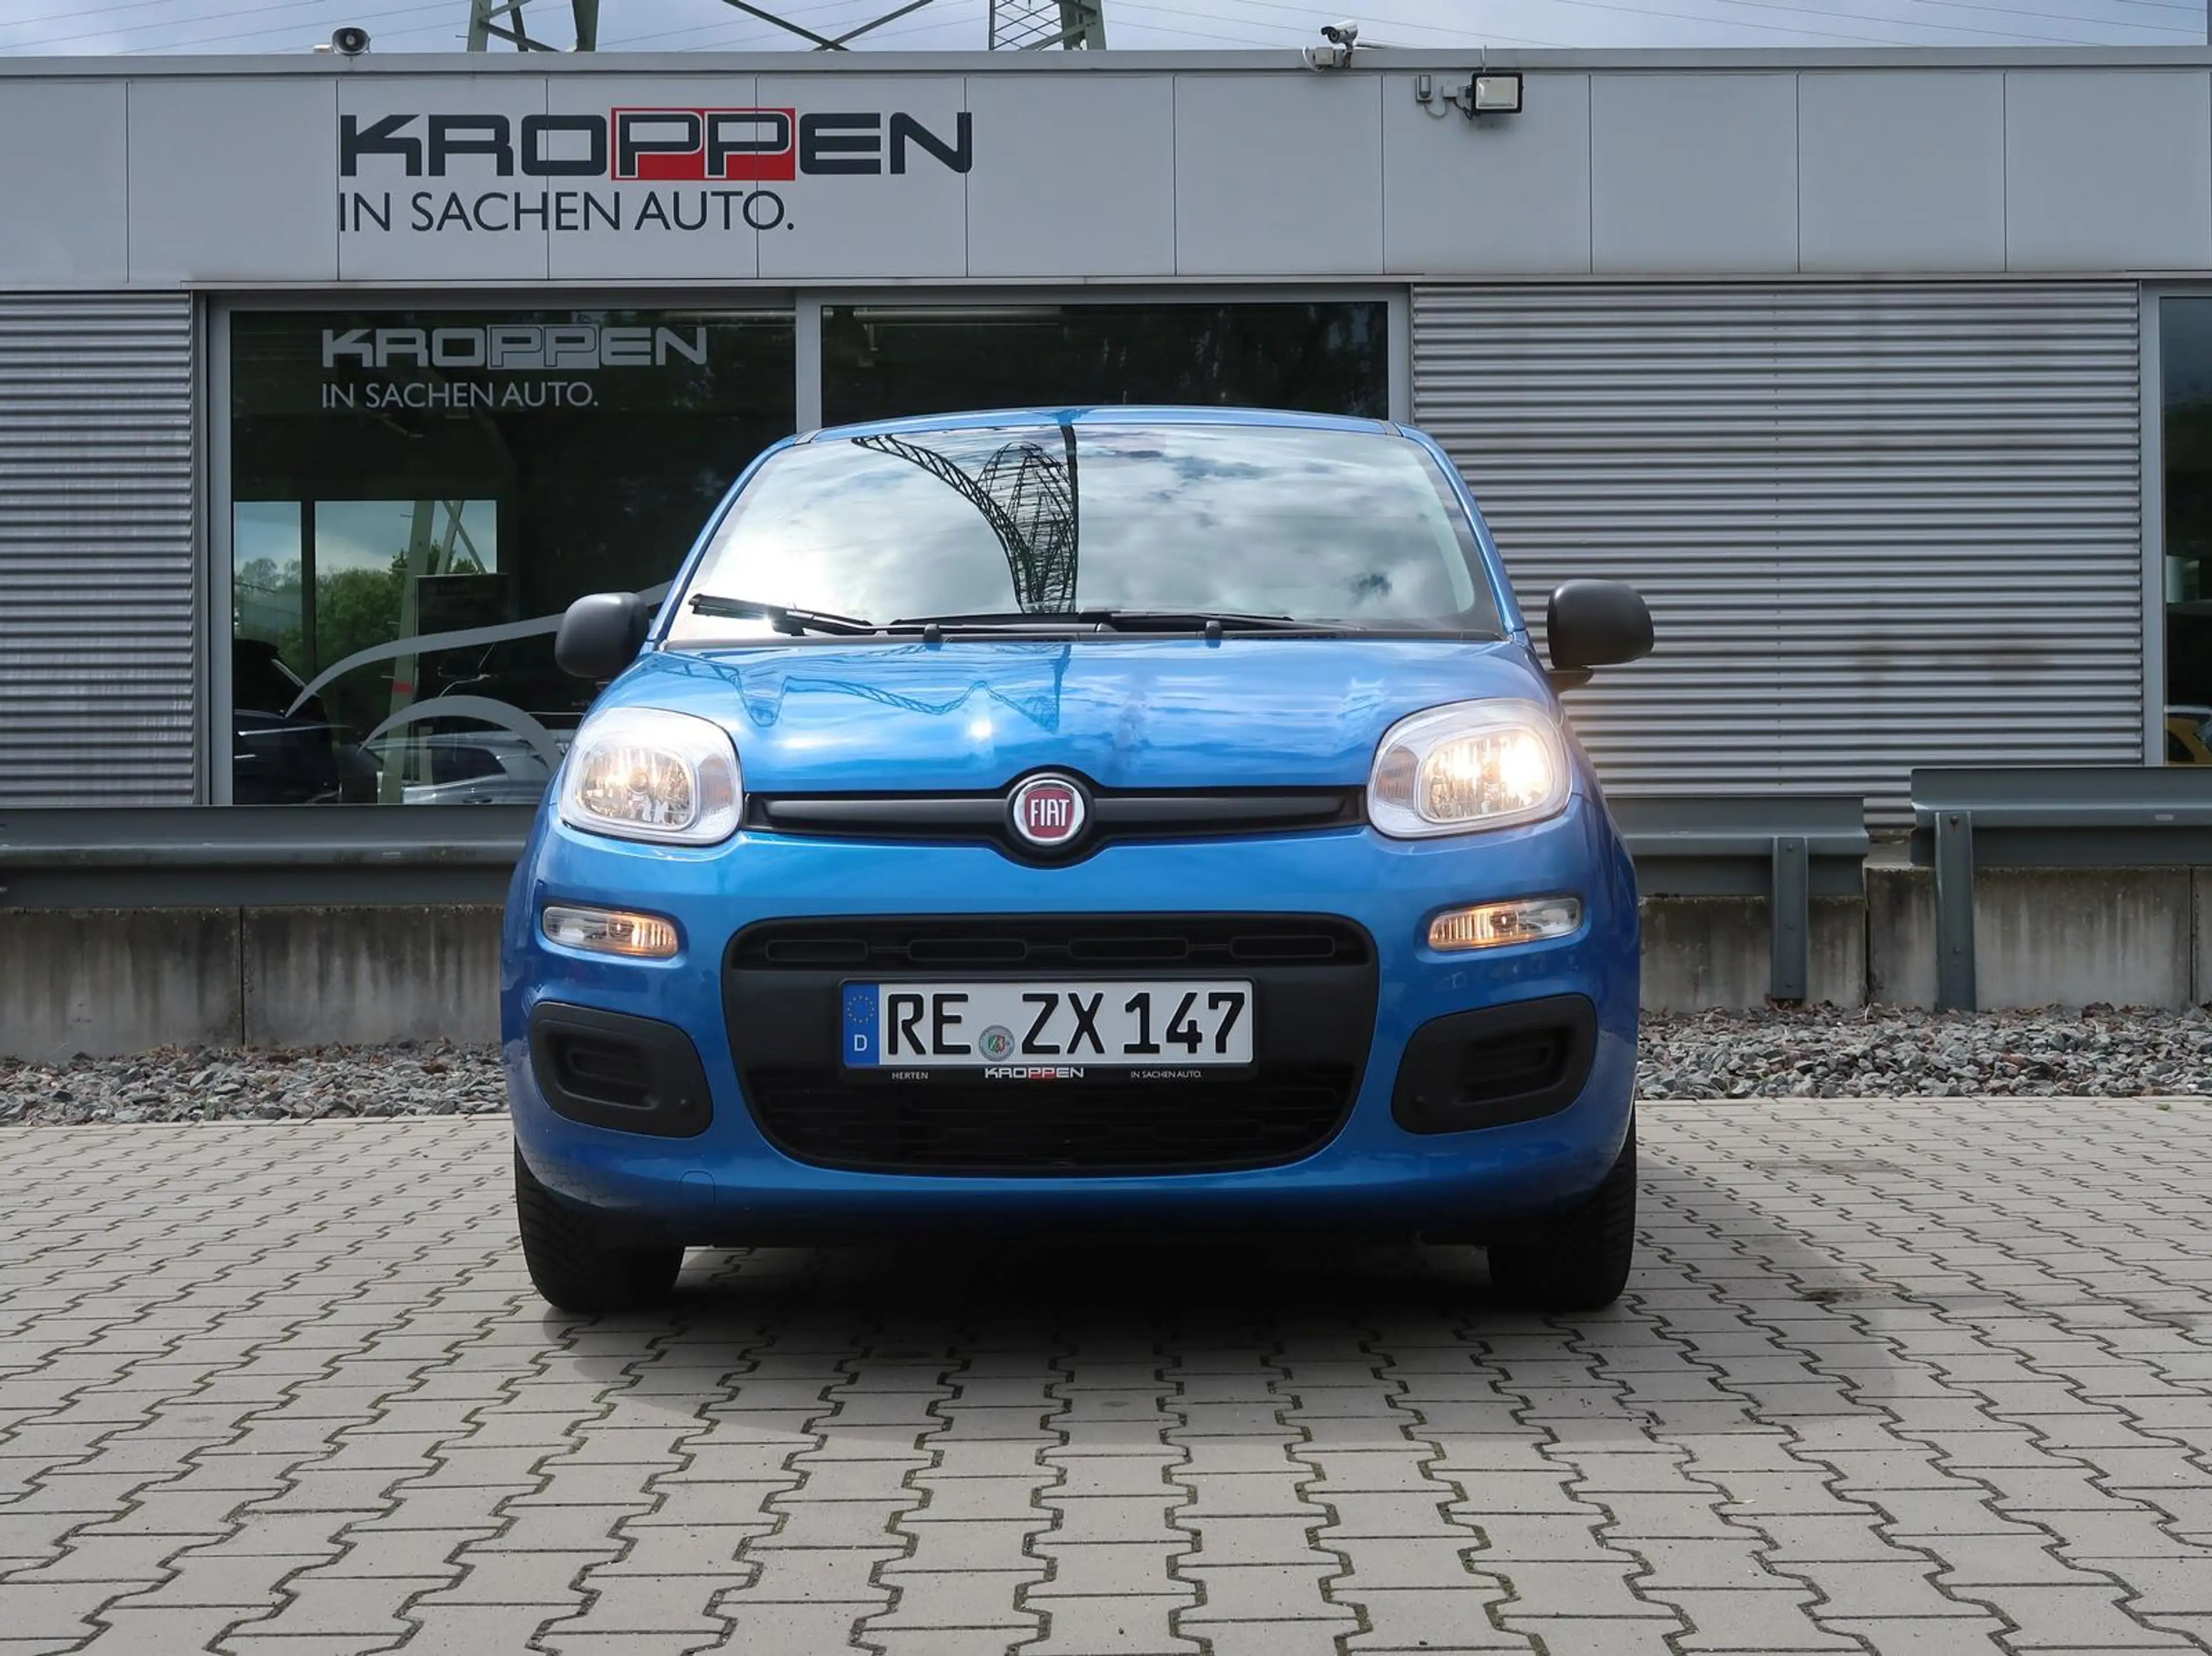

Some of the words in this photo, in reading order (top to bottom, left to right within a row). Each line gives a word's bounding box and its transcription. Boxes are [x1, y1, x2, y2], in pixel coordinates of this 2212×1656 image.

[340, 112, 973, 176] KROPPEN
[340, 192, 391, 232] IN
[411, 191, 620, 232] SACHEN
[634, 190, 794, 230] AUTO.
[322, 327, 707, 367] KROPPEN
[322, 383, 354, 409] IN
[365, 382, 494, 408] SACHEN
[500, 381, 599, 407] AUTO.
[1030, 798, 1070, 827] FIAT
[887, 994, 972, 1055] RE
[1021, 992, 1105, 1055] ZX
[1124, 992, 1245, 1054] 147
[854, 1034, 868, 1052] D
[984, 1067, 1084, 1079] KROPPEN
